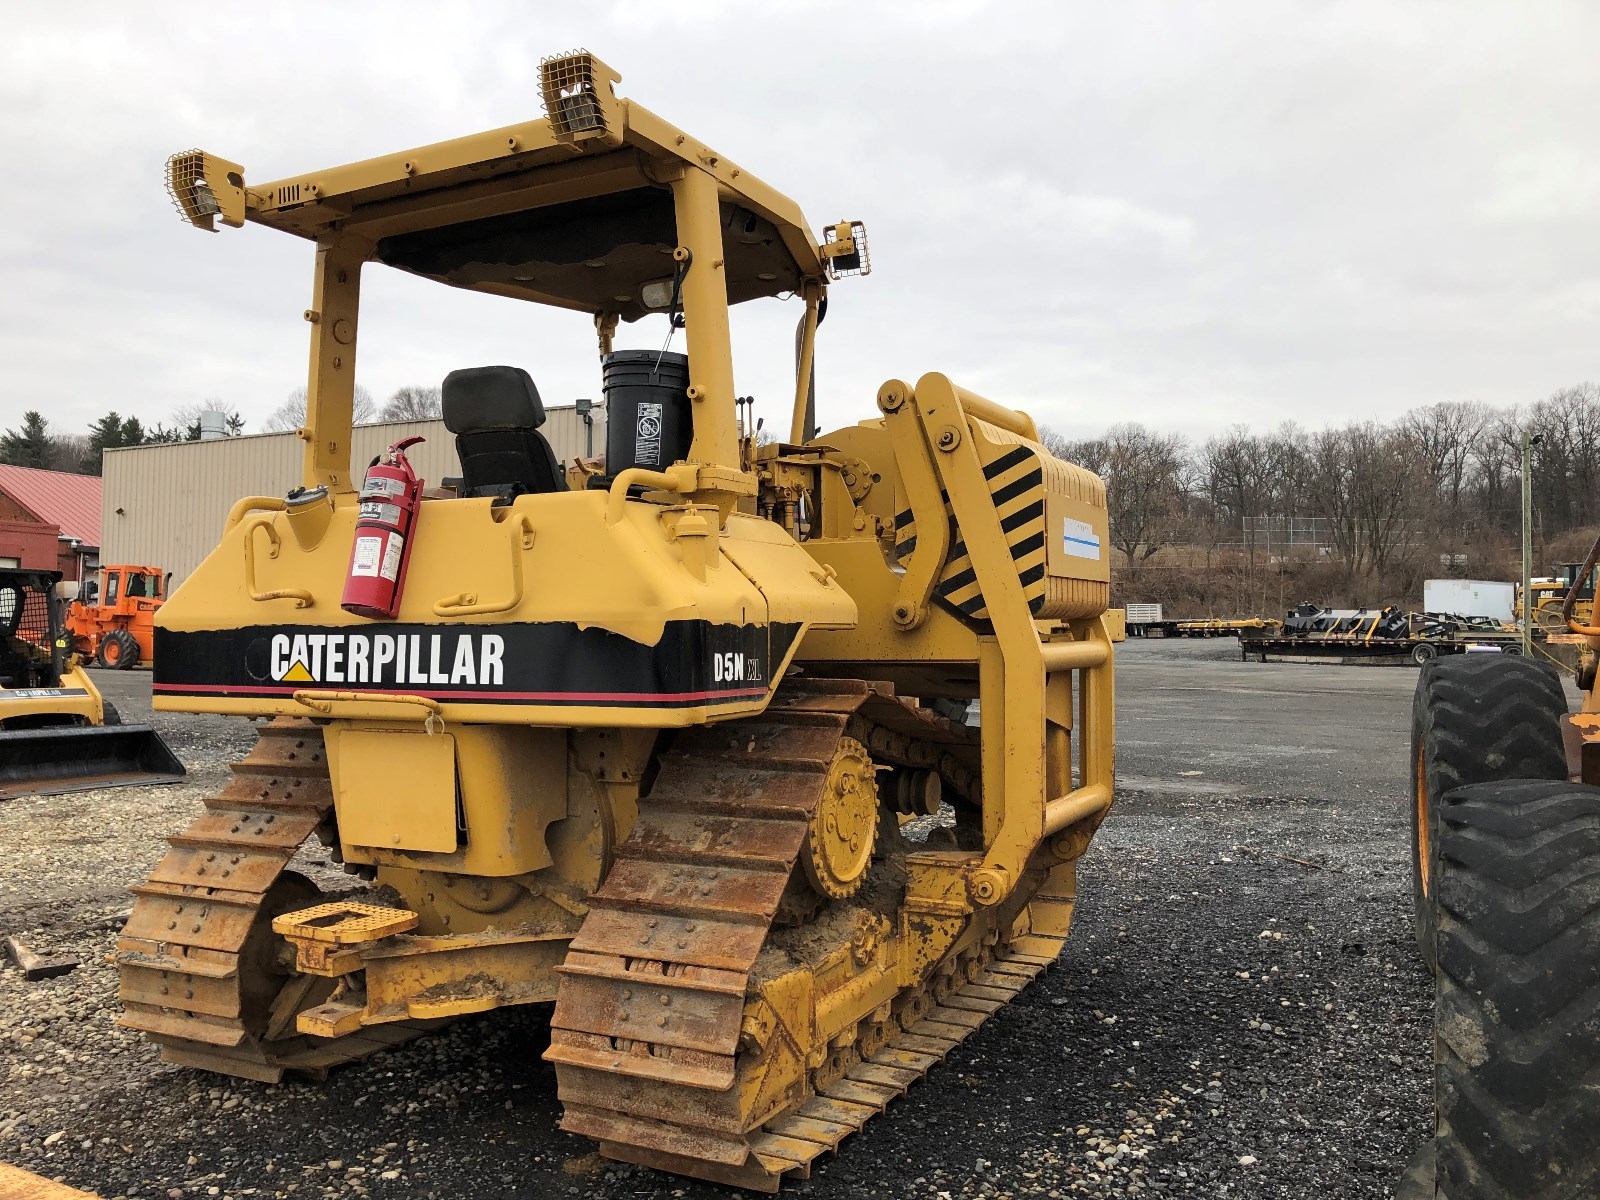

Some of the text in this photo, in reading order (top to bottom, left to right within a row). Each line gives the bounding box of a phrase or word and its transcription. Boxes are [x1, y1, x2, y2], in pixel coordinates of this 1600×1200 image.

[1540, 590, 1554, 598] CAT
[271, 633, 505, 685] CATERPILLAR
[714, 652, 744, 682] D5N
[15, 689, 62, 697] CATERPILLAR
